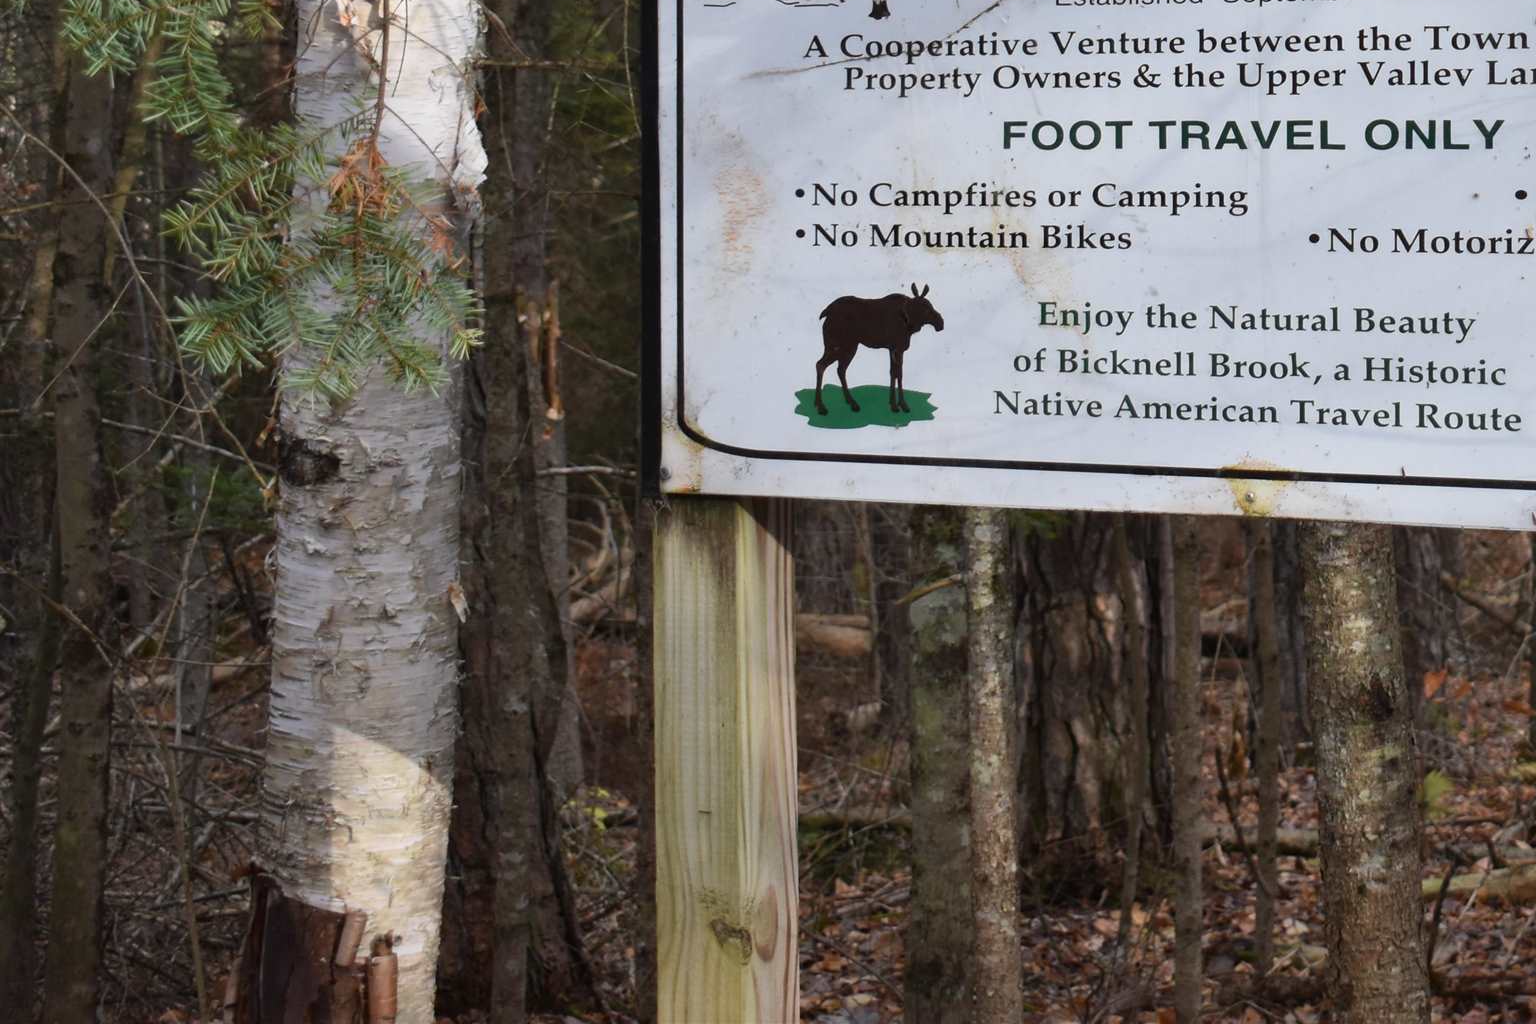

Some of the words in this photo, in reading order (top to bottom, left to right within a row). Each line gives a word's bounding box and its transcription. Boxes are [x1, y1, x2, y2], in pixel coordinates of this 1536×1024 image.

[803, 35, 829, 58] A
[840, 32, 1037, 65] Cooperative
[1049, 32, 1185, 54] Venture
[1197, 29, 1344, 53] between
[1357, 26, 1411, 51] the
[1424, 26, 1529, 50] Town
[844, 67, 981, 98] Property
[993, 65, 1121, 89] Owners
[1134, 64, 1161, 88] &
[1173, 63, 1224, 87] the
[1237, 63, 1346, 95] Upper
[1004, 121, 1133, 150] FOOT
[1149, 120, 1345, 150] TRAVEL
[1365, 119, 1504, 150] ONLY
[869, 182, 1036, 214] Campfires
[1048, 191, 1081, 207] or
[1092, 183, 1248, 216] Camping
[870, 224, 1029, 248] Mountain
[1041, 225, 1131, 249] Bikes
[1038, 302, 1134, 335] Enjoy
[1146, 304, 1197, 329] the
[1209, 306, 1340, 331] Natural
[1354, 308, 1476, 343] Beauty
[1014, 348, 1046, 372] of
[1057, 349, 1196, 376] Bicknell
[1209, 352, 1321, 385] Brook,
[1334, 364, 1351, 381] a
[1364, 357, 1506, 385] Historic
[994, 391, 1102, 417] Native
[1114, 395, 1279, 423] American
[1290, 400, 1402, 427] Travel
[1416, 404, 1521, 431] Route
